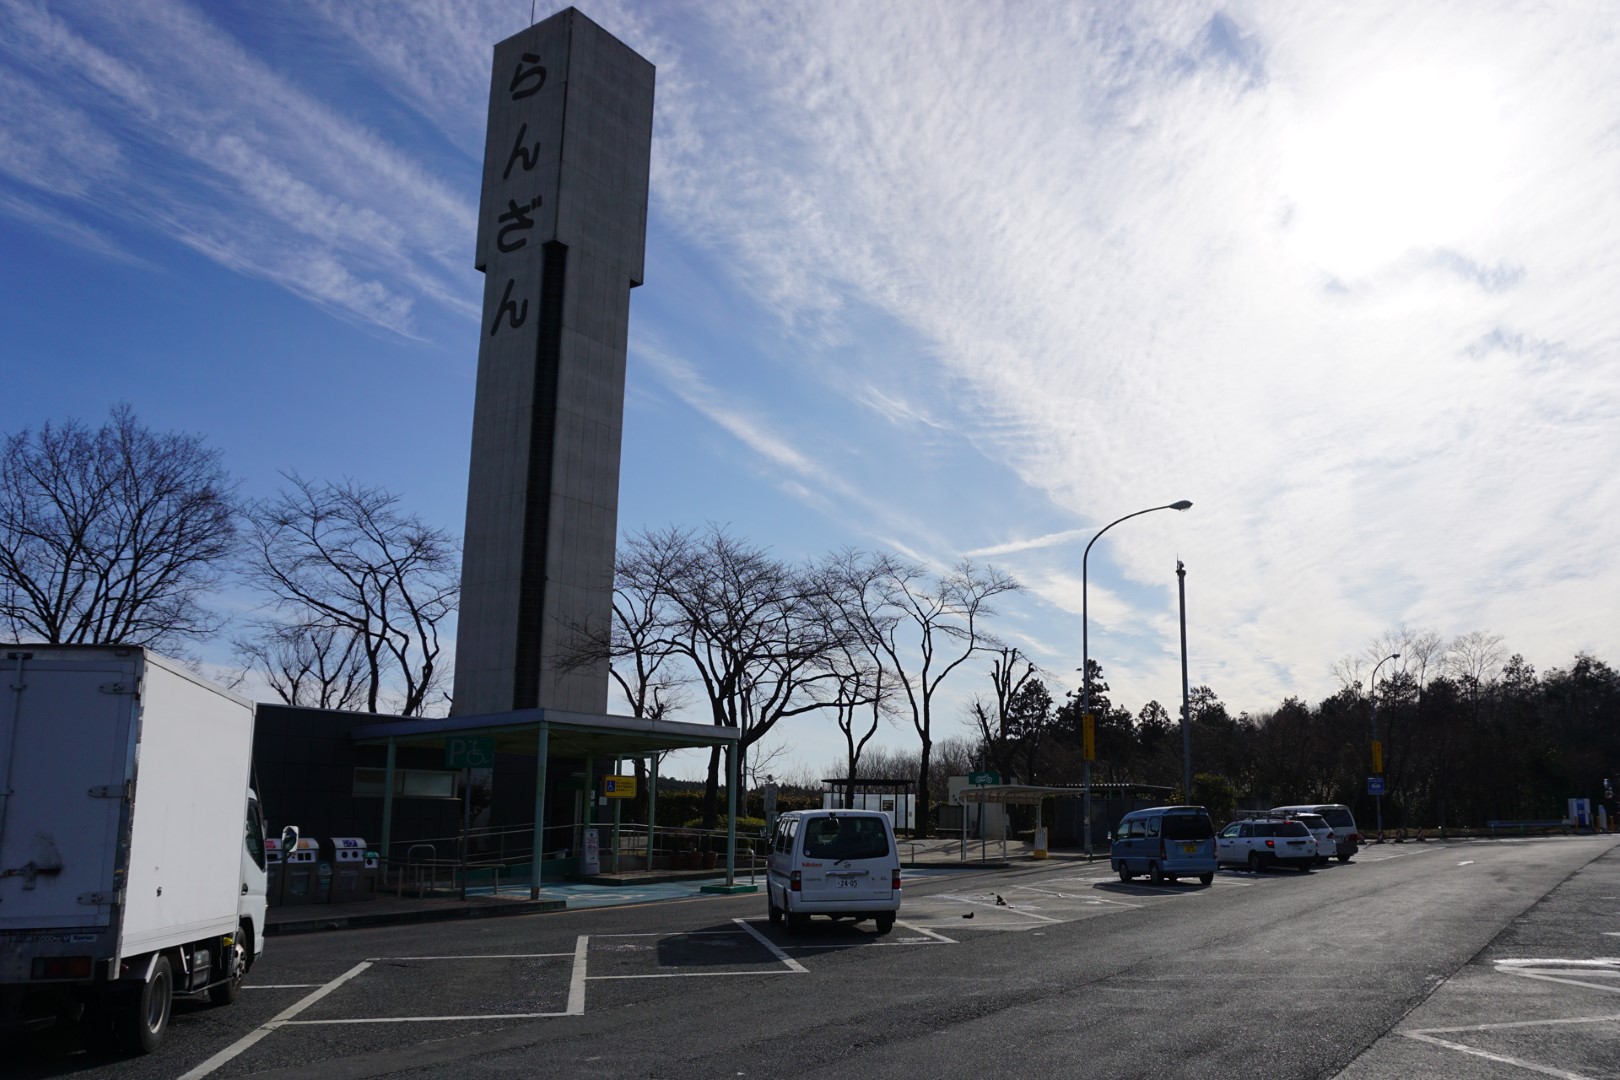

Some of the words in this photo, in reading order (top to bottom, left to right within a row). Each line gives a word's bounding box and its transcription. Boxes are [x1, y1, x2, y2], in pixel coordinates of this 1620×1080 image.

[490, 52, 547, 337] らんざん
[449, 738, 467, 765] P
